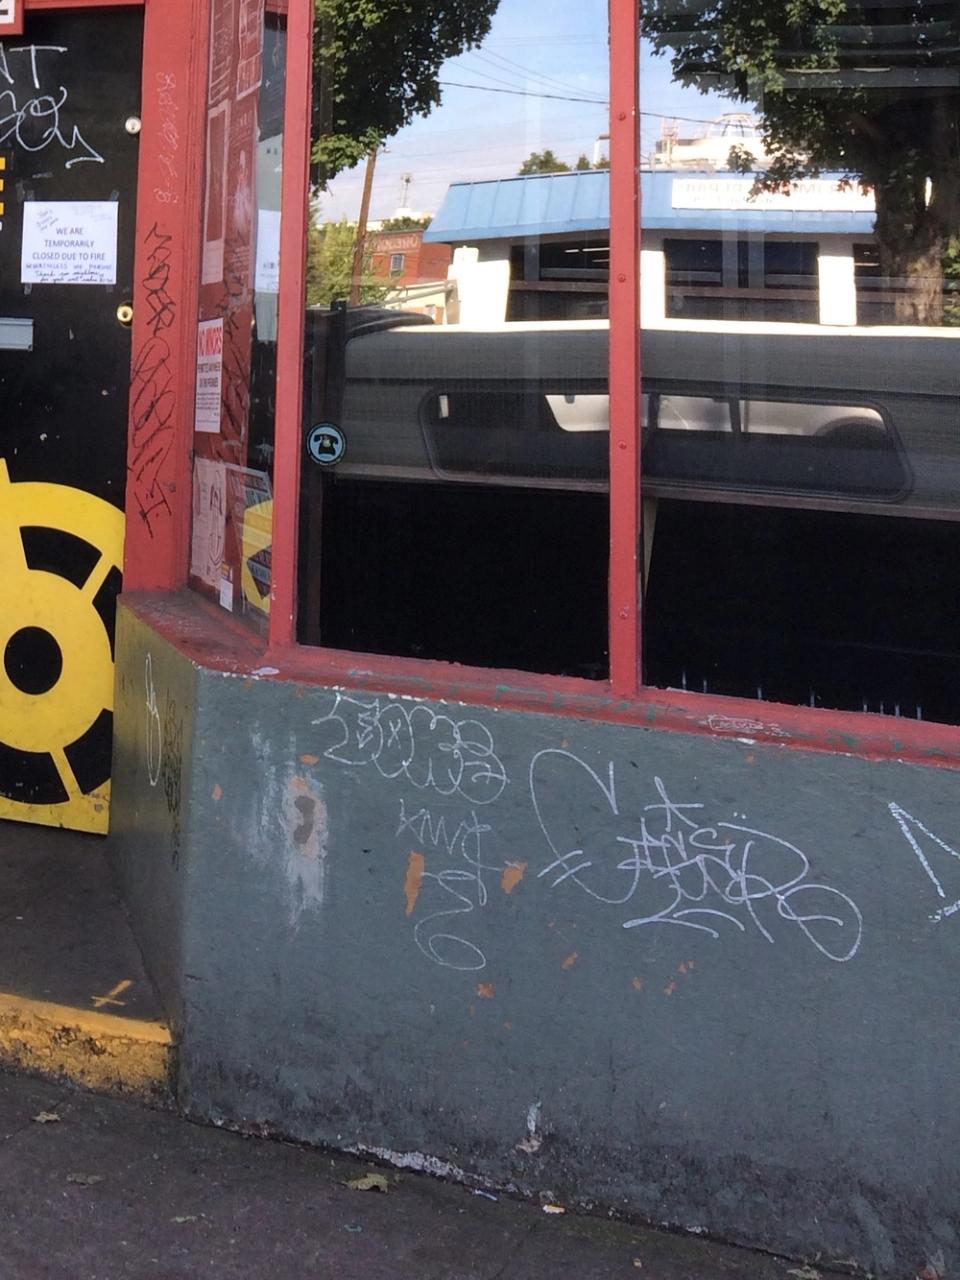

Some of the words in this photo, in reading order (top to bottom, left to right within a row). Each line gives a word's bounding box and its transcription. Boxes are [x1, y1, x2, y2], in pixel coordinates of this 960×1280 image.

[55, 227, 68, 236] WE
[69, 227, 84, 235] ARE
[44, 239, 95, 248] TEMPORARILY
[31, 252, 61, 261] CLOSED
[61, 252, 76, 261] DUE
[79, 252, 89, 261] TO
[90, 252, 106, 261] FIRE
